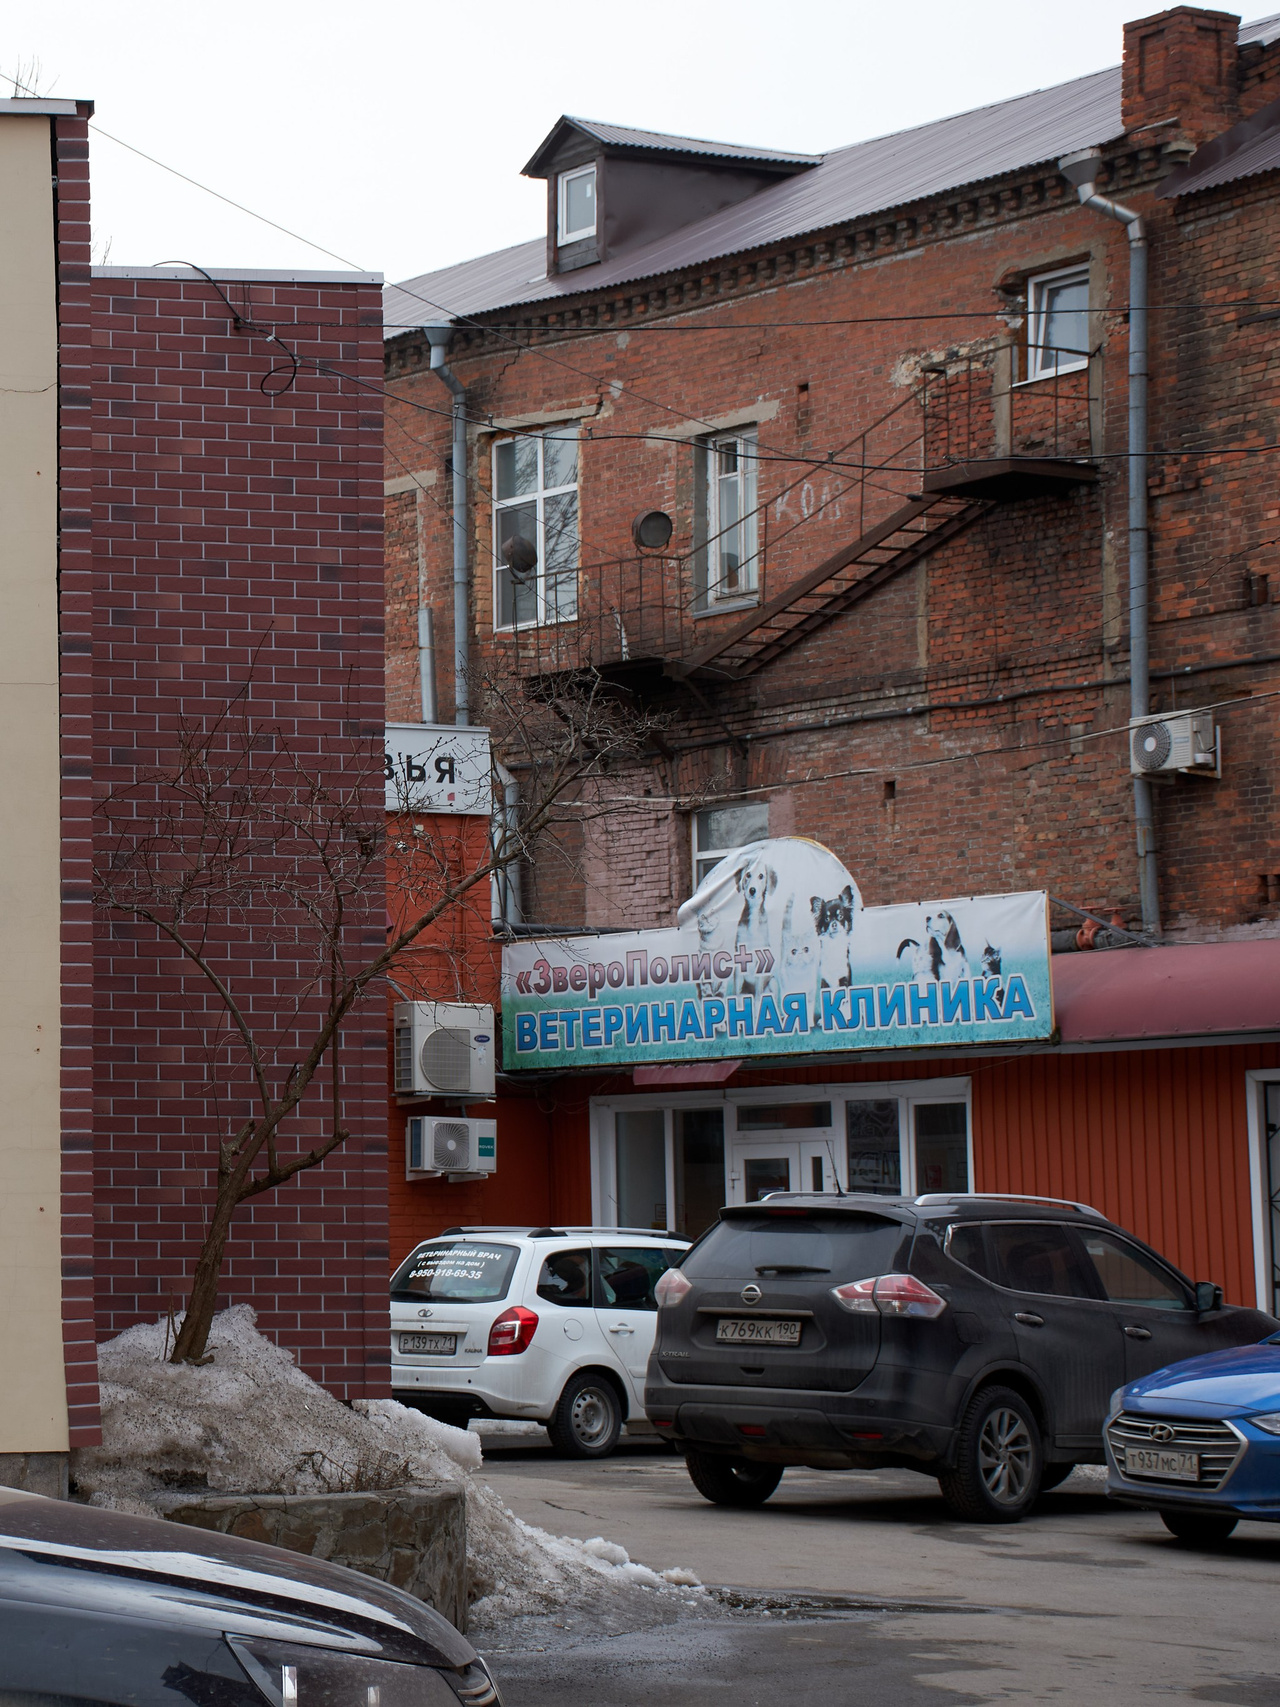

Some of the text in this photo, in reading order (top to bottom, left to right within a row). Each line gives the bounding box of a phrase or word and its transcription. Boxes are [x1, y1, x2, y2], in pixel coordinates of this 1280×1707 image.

[515, 945, 775, 999] «ЗвероПолис+»
[516, 976, 1035, 1051] ВЕТЕРИНАРНАЯ КЛИНИКА
[417, 1250, 501, 1260] ВЕТЕРИНАРНЫЙ ВРАЧ
[409, 1269, 482, 1279] 8-950-918-69-35
[442, 1337, 453, 1347] 71
[1180, 1454, 1194, 1469] 71
